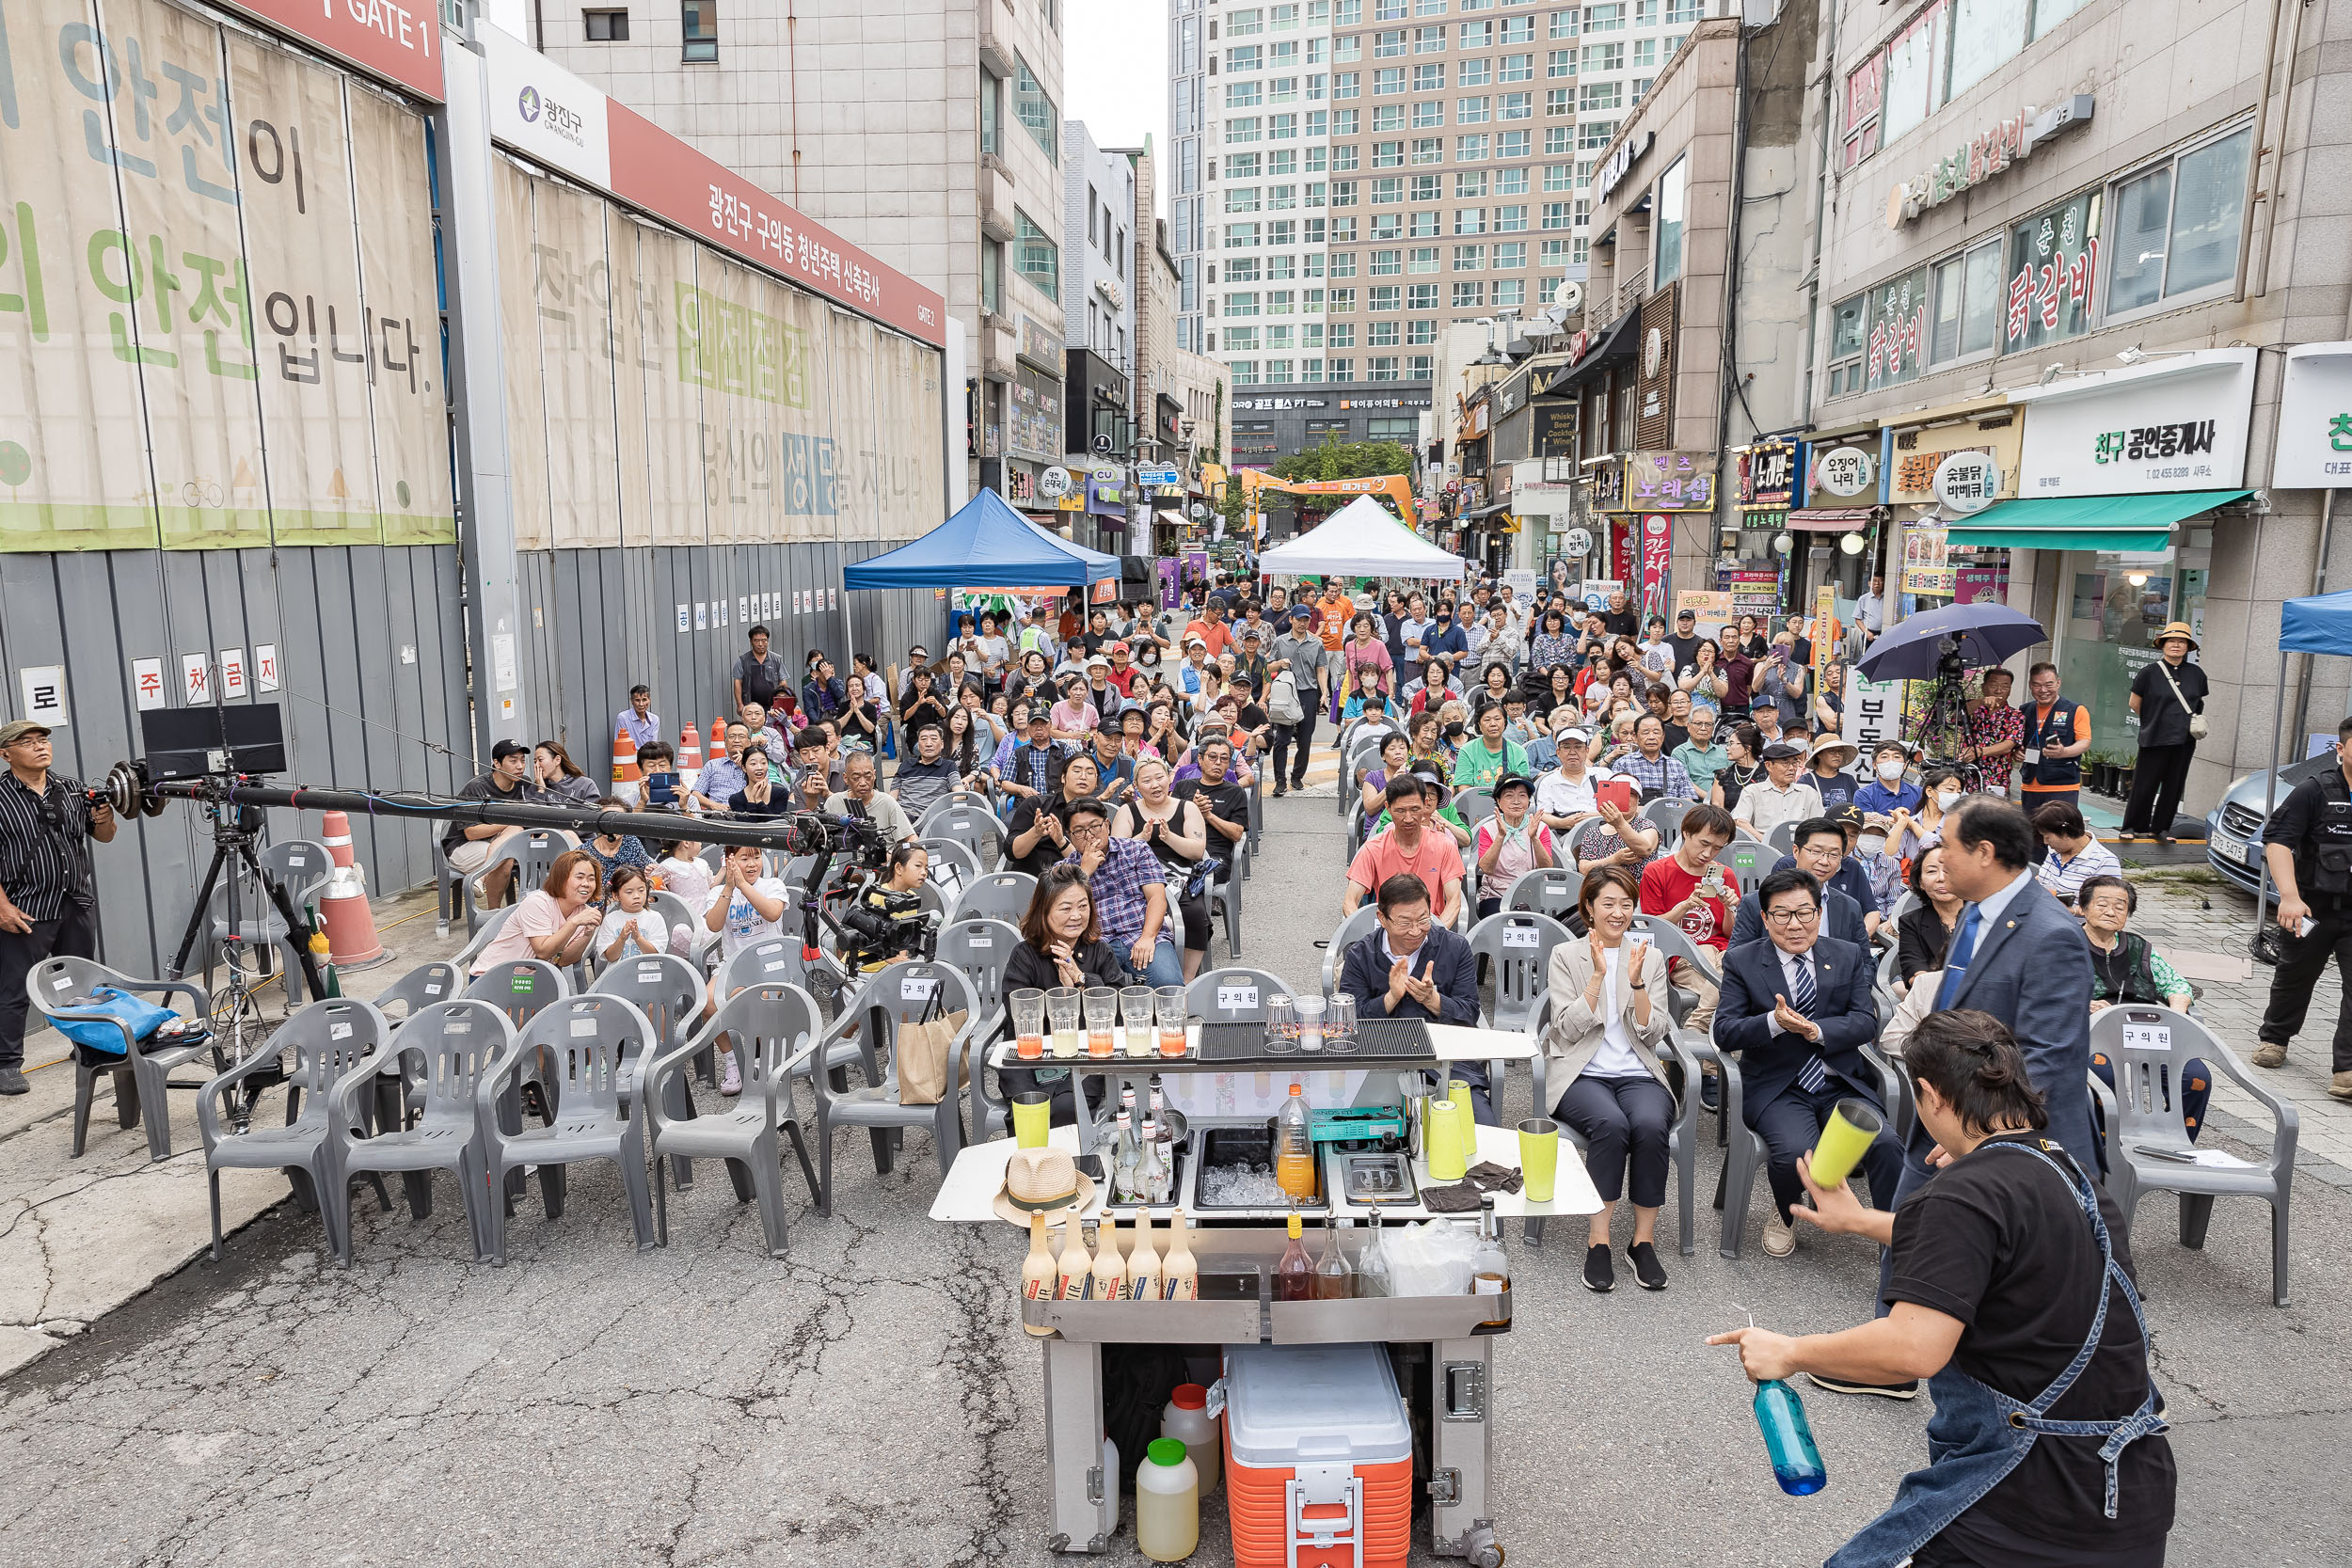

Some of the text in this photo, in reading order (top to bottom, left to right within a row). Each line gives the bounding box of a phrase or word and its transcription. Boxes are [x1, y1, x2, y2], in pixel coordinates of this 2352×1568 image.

[419, 21, 430, 57] 1
[59, 22, 306, 215] 안전이
[544, 97, 582, 134] 광진구
[544, 119, 584, 148] GWANGJIN-GU
[2037, 207, 2077, 257] 춘천
[708, 183, 881, 308] 광진구 구의동 청년주택 신축공사
[1884, 280, 1911, 316] 춘천
[2008, 237, 2098, 342] 닭갈비
[1868, 305, 1925, 381] 닭갈비
[1254, 399, 1273, 410] 골프
[1274, 398, 1292, 410] 헬스
[1295, 399, 1305, 407] PT
[1549, 413, 1576, 421] Whisky
[2094, 419, 2216, 465] 친구 공인중개사
[1828, 457, 1858, 472] 오징어
[1947, 466, 1982, 483] 숯불닭
[2325, 462, 2351, 474] 대표
[1833, 473, 1853, 487] 나라
[1947, 483, 1982, 499] 바베큐
[1732, 607, 1776, 615] 오징어 나라
[139, 657, 277, 699] 주차금지
[33, 685, 59, 711] 로
[2226, 840, 2243, 859] 5475
[1504, 933, 1538, 942] 구의원
[1218, 992, 1257, 1003] 구의원
[2124, 1030, 2168, 1043] 구의원
